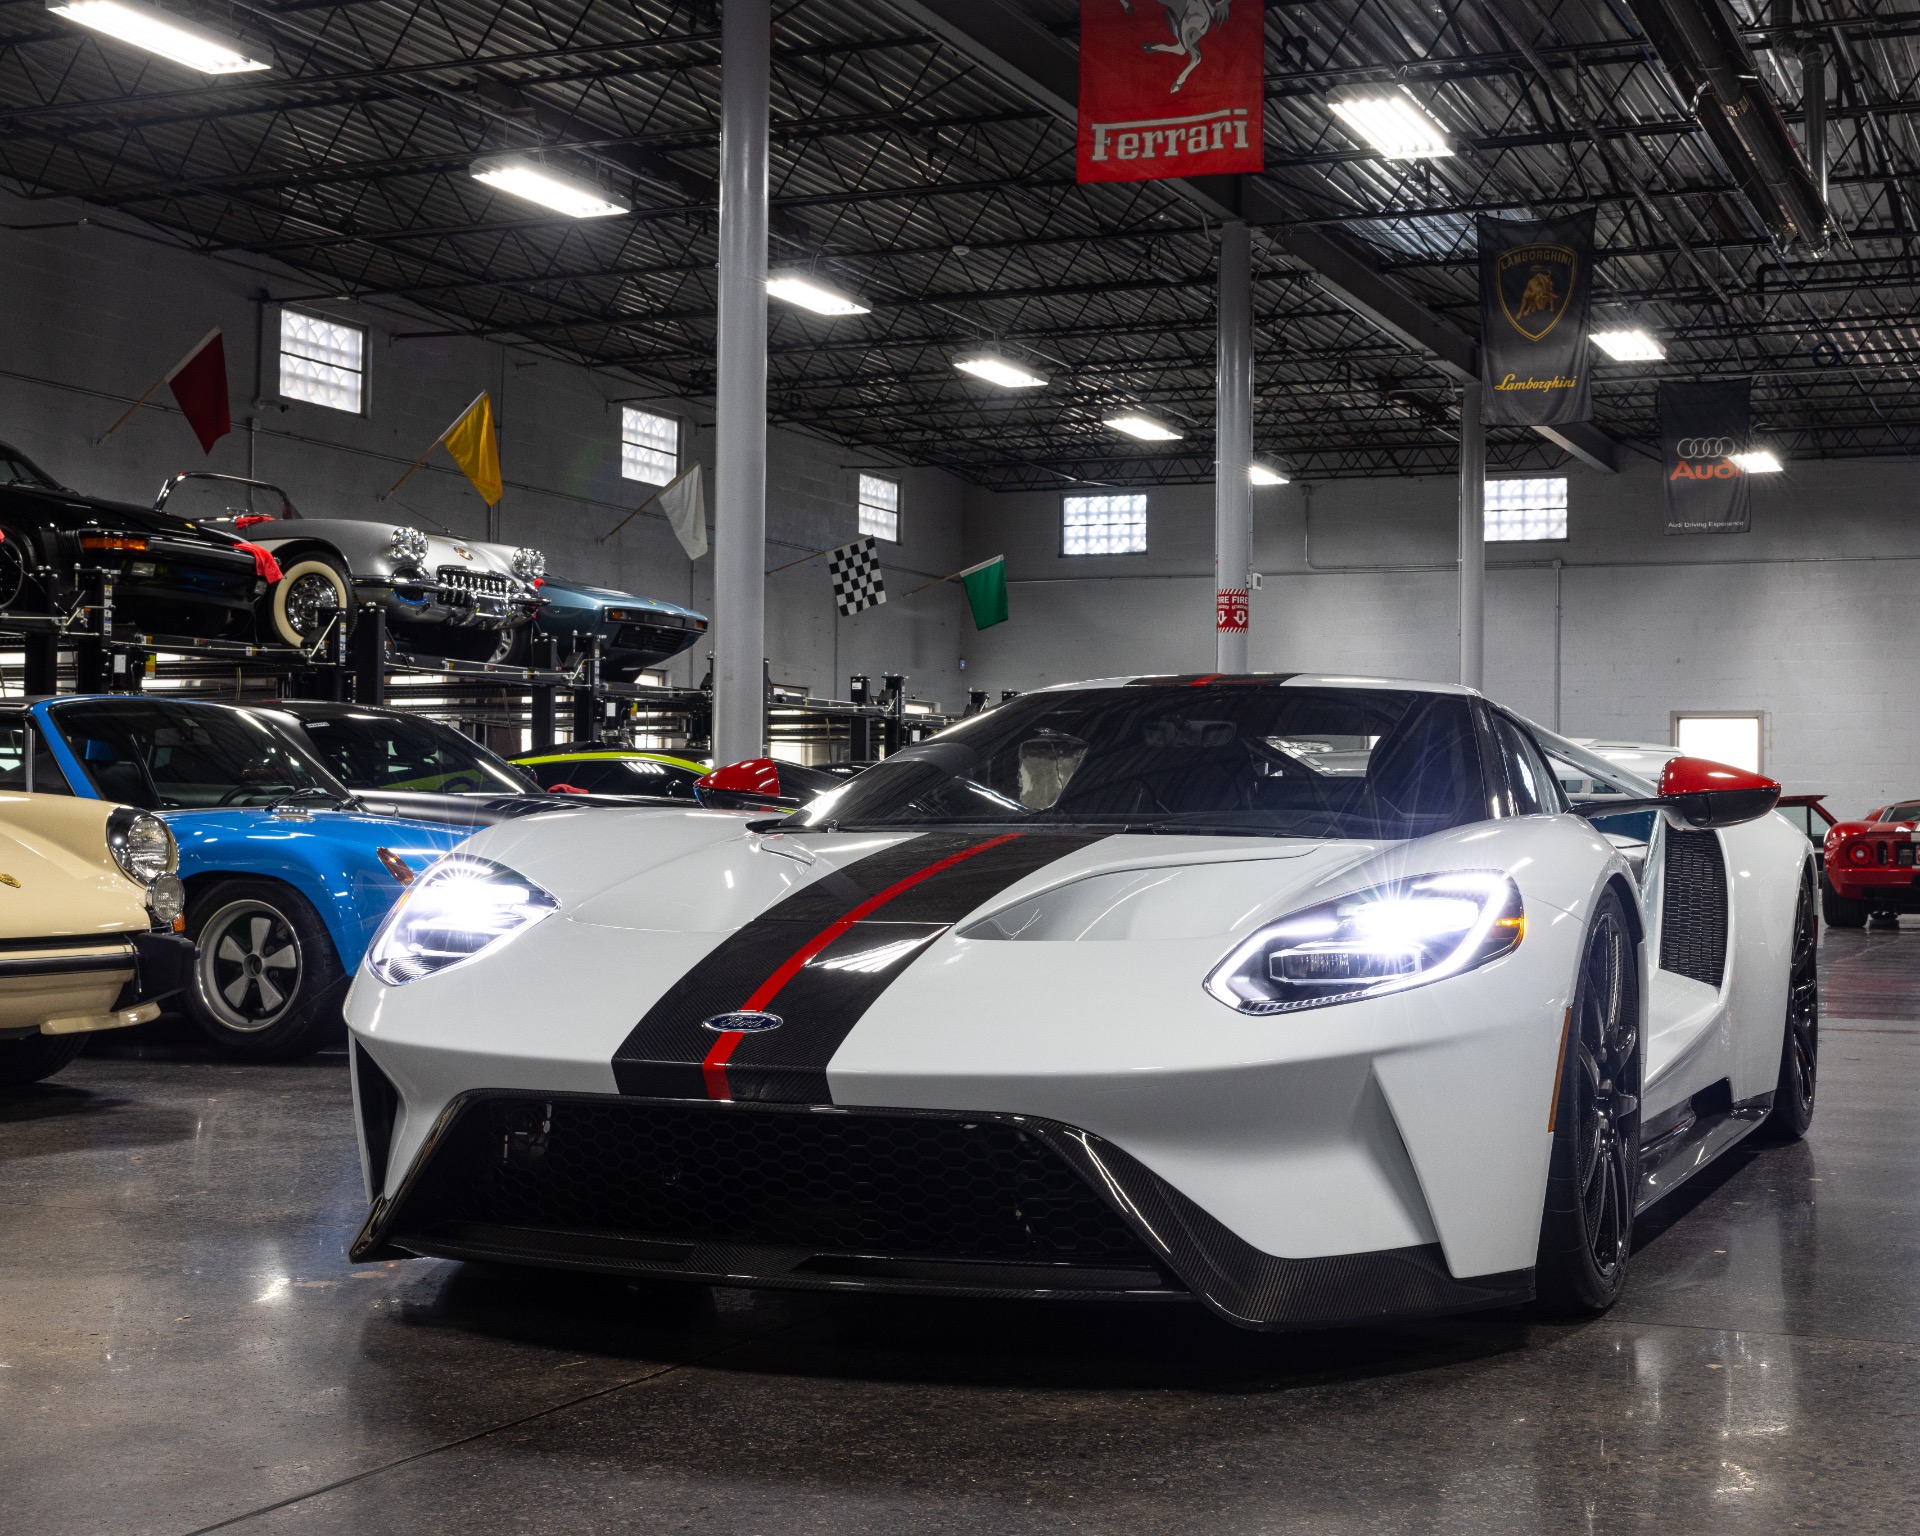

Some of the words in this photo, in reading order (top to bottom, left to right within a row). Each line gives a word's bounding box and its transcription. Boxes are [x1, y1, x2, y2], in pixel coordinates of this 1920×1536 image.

[1091, 108, 1249, 161] Ferrari
[1500, 250, 1572, 270] LAMBORGHINI
[1494, 373, 1577, 393] Lamborghini
[1669, 459, 1742, 480] Audi
[1231, 596, 1248, 604] FIRE
[720, 1015, 765, 1027] Ford
